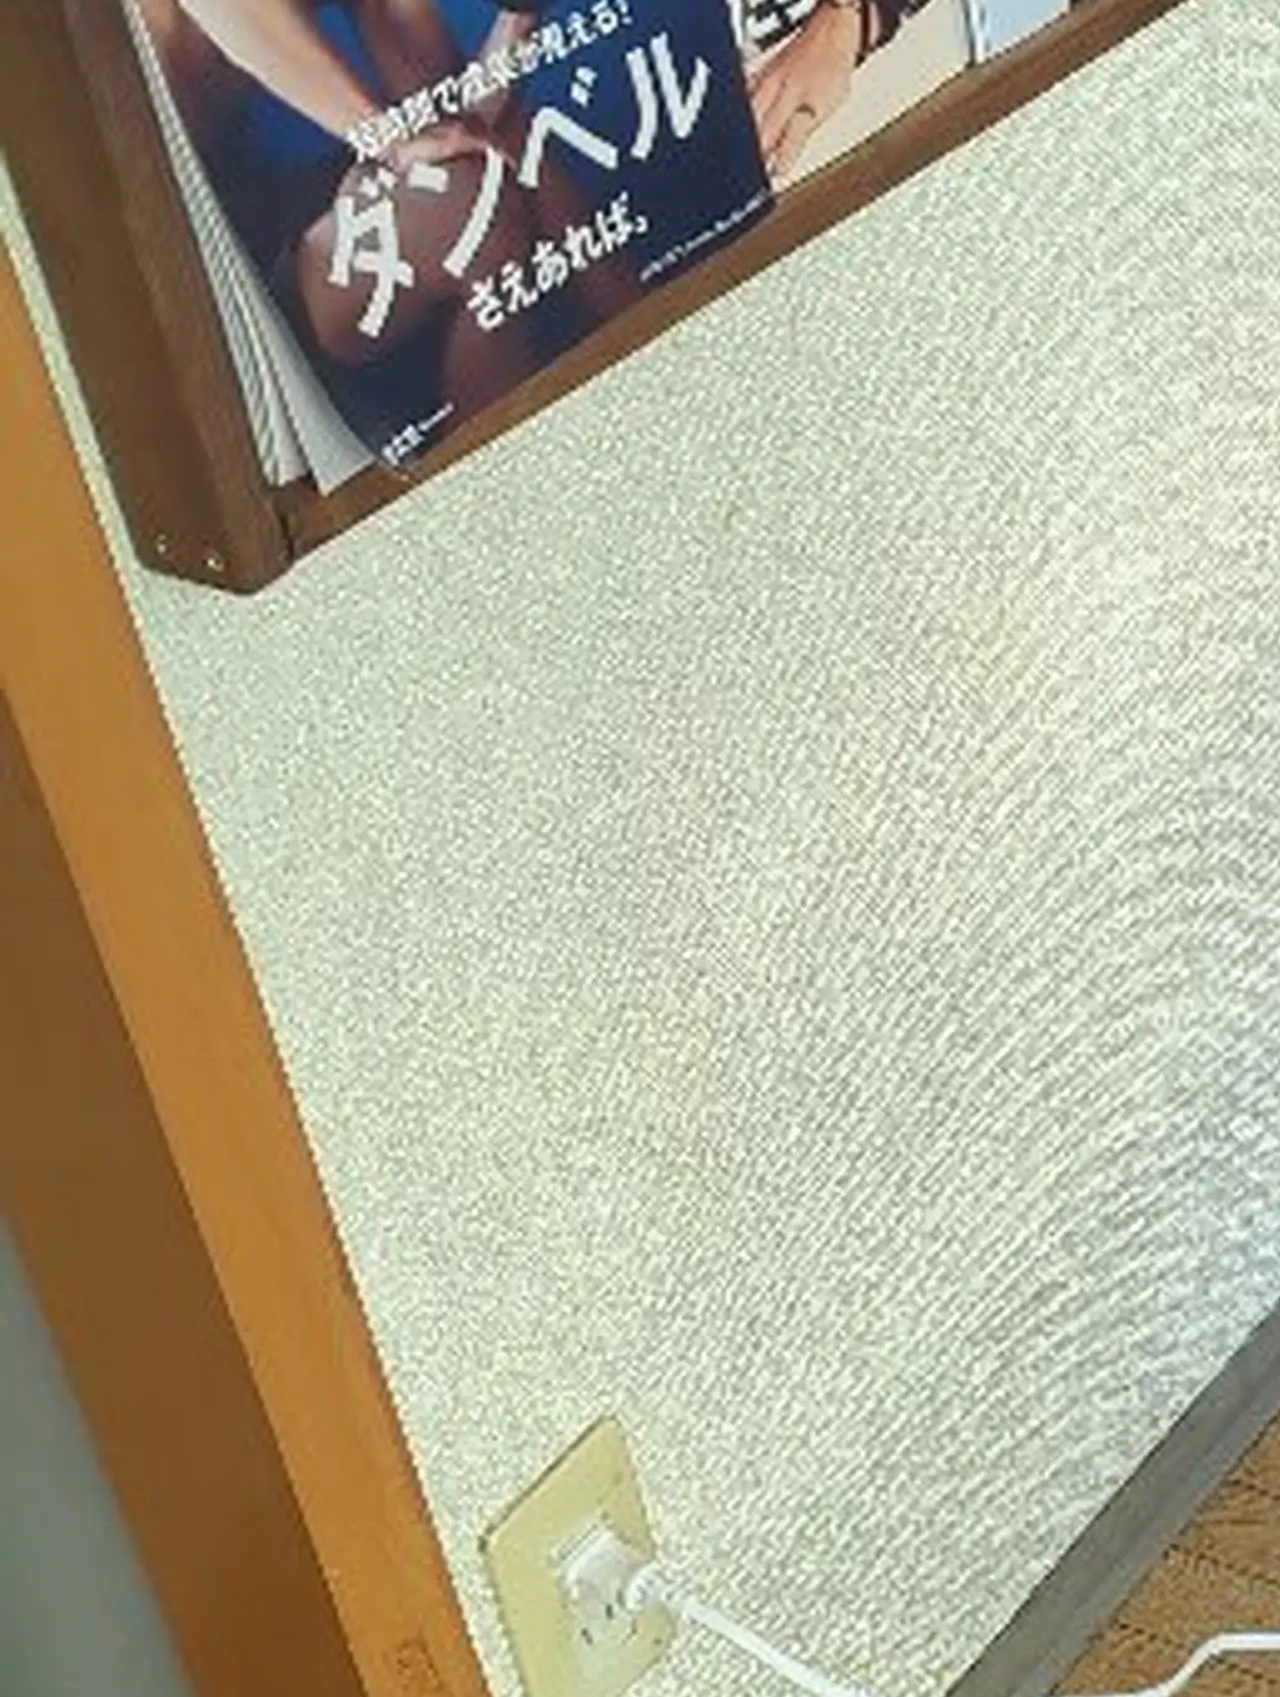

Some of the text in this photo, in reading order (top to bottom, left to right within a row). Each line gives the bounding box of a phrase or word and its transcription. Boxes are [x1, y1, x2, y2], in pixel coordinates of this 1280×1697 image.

[326, 31, 712, 338] ダンベル
[467, 191, 648, 333] さえあれば。
